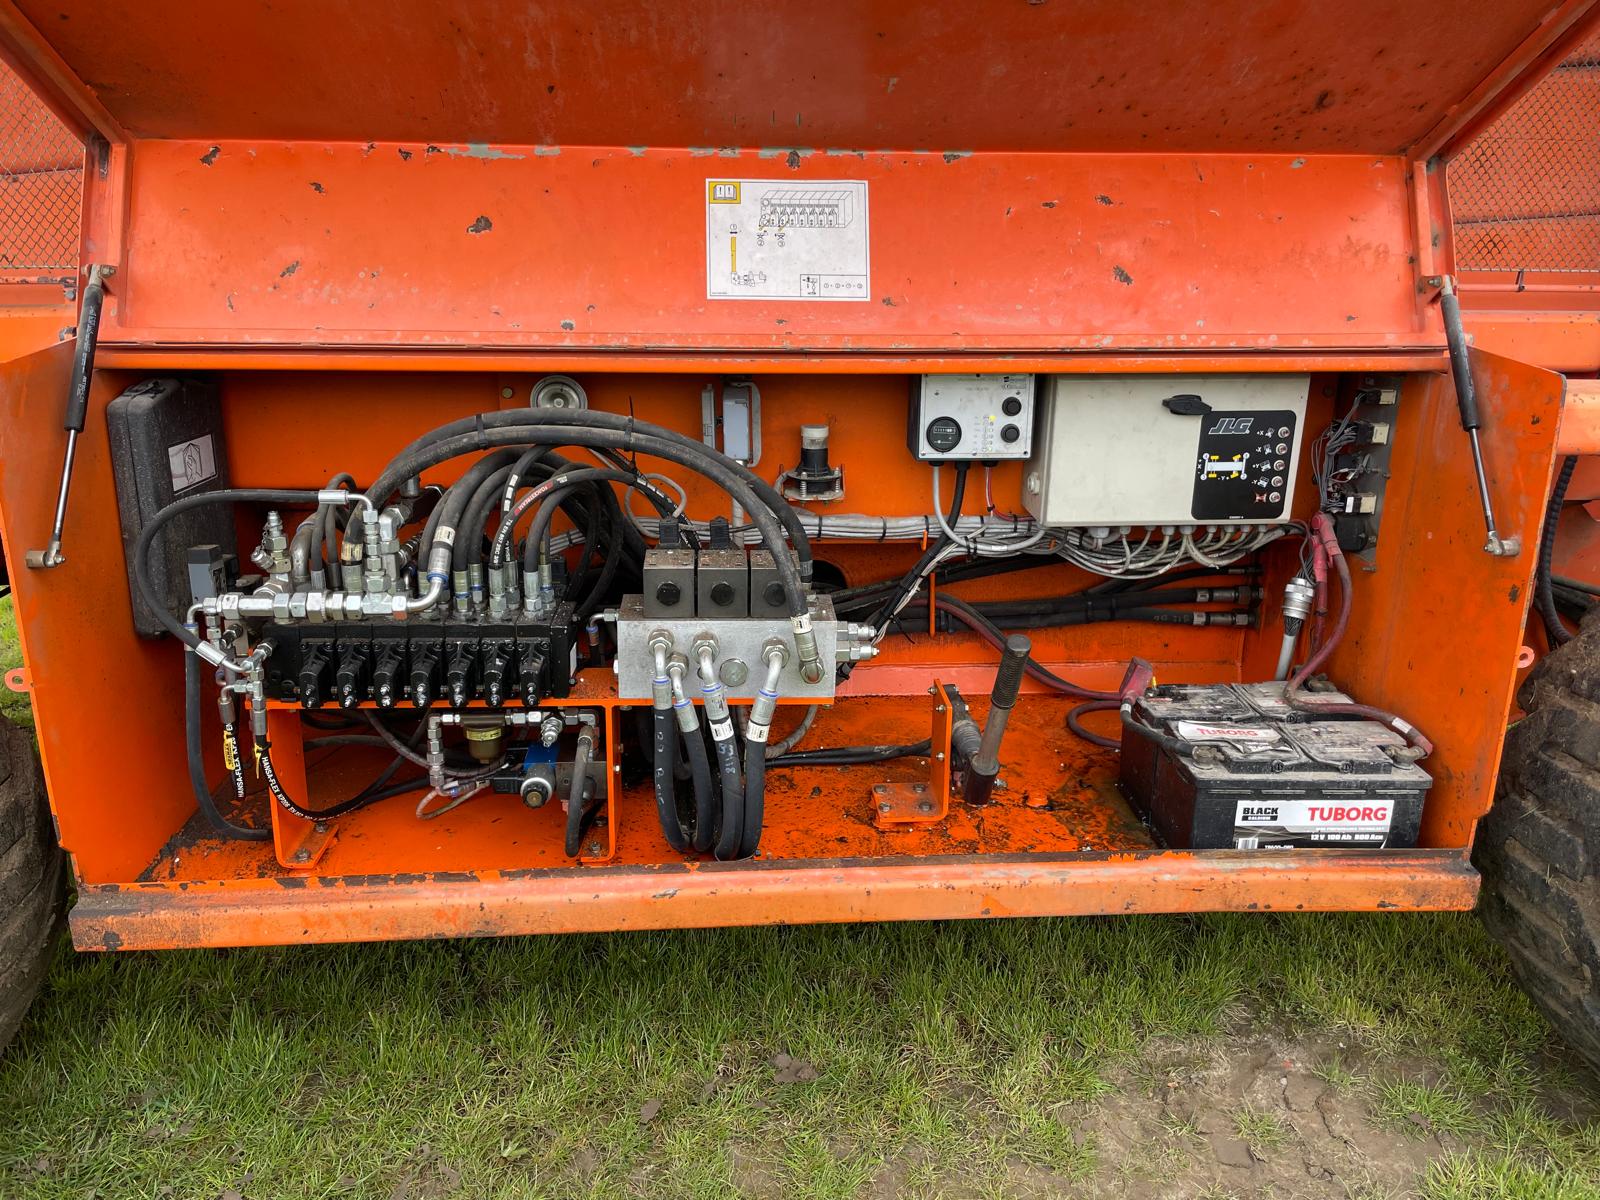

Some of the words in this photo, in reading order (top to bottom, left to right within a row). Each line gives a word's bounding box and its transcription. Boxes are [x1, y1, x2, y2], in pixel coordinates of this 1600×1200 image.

[1208, 418, 1254, 434] JLG
[1197, 727, 1259, 737] TUBORG
[261, 756, 280, 793] HANSA-FLEX
[1243, 807, 1279, 815] BLACK
[1308, 807, 1388, 821] TUBORG
